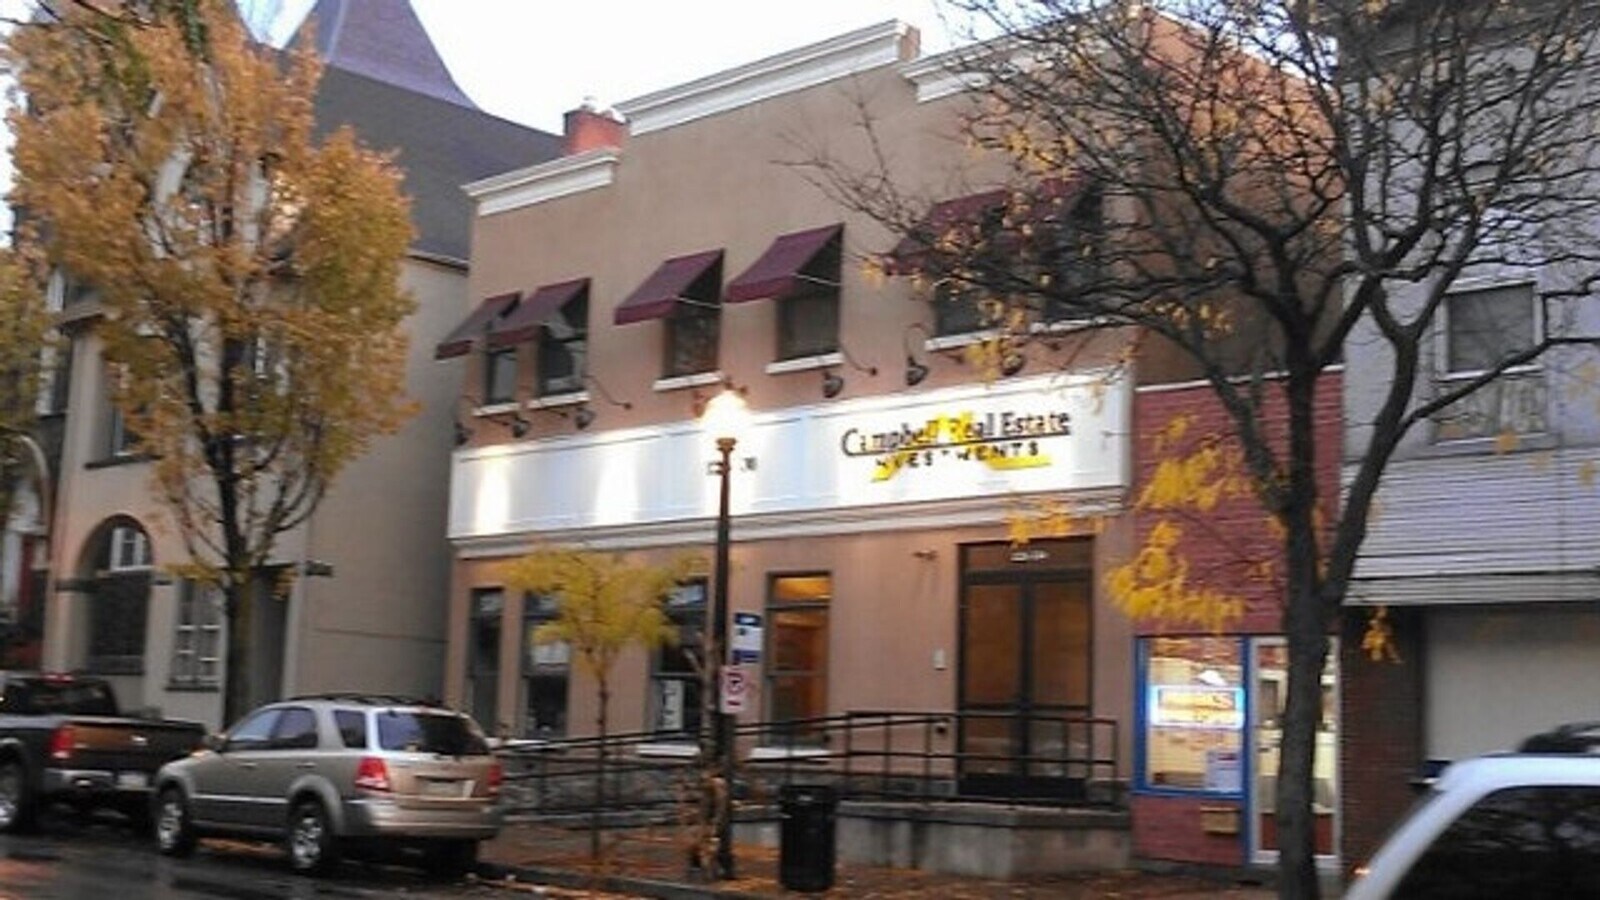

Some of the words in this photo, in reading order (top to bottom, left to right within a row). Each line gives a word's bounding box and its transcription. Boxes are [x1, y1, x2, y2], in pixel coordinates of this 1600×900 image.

[841, 418, 939, 457] Campbell
[947, 412, 995, 443] Real
[999, 410, 1071, 437] Estate
[871, 440, 1039, 469] NVESTMENTS
